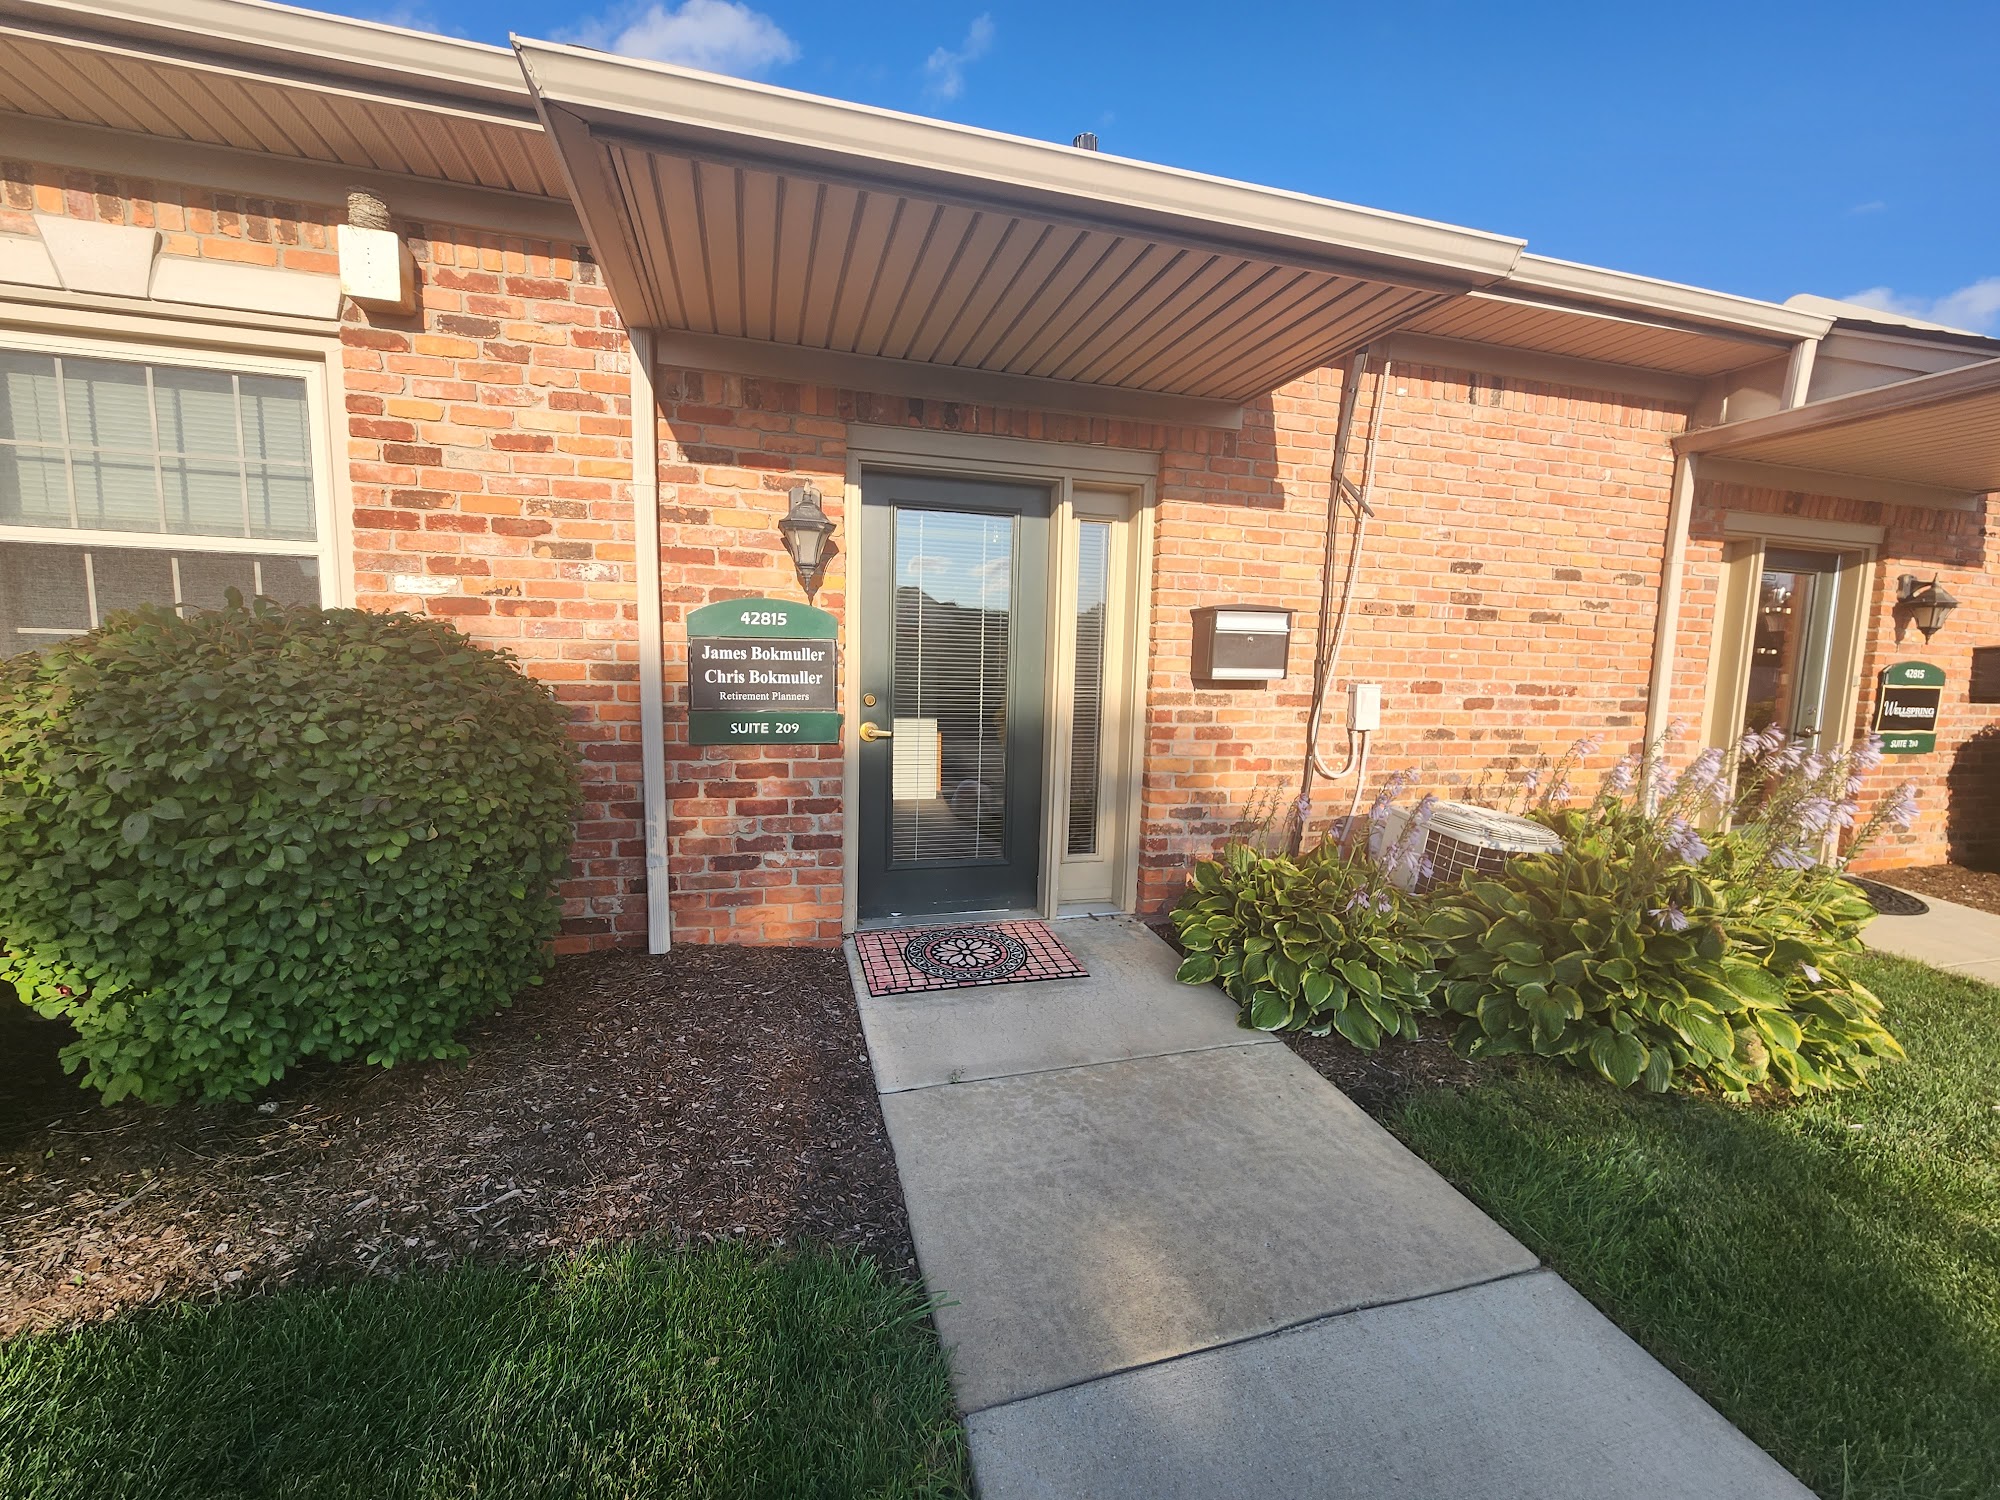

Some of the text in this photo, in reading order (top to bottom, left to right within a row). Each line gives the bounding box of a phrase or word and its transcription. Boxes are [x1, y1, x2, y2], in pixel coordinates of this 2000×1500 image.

[740, 611, 788, 626] 42815
[701, 645, 826, 662] James Bokmuller
[704, 669, 824, 685] Chris Bokmuller
[1905, 669, 1925, 679] 42815
[719, 691, 810, 701] Retirement Planners
[730, 722, 800, 734] SUITE 209
[1890, 739, 1907, 748] SUITE
